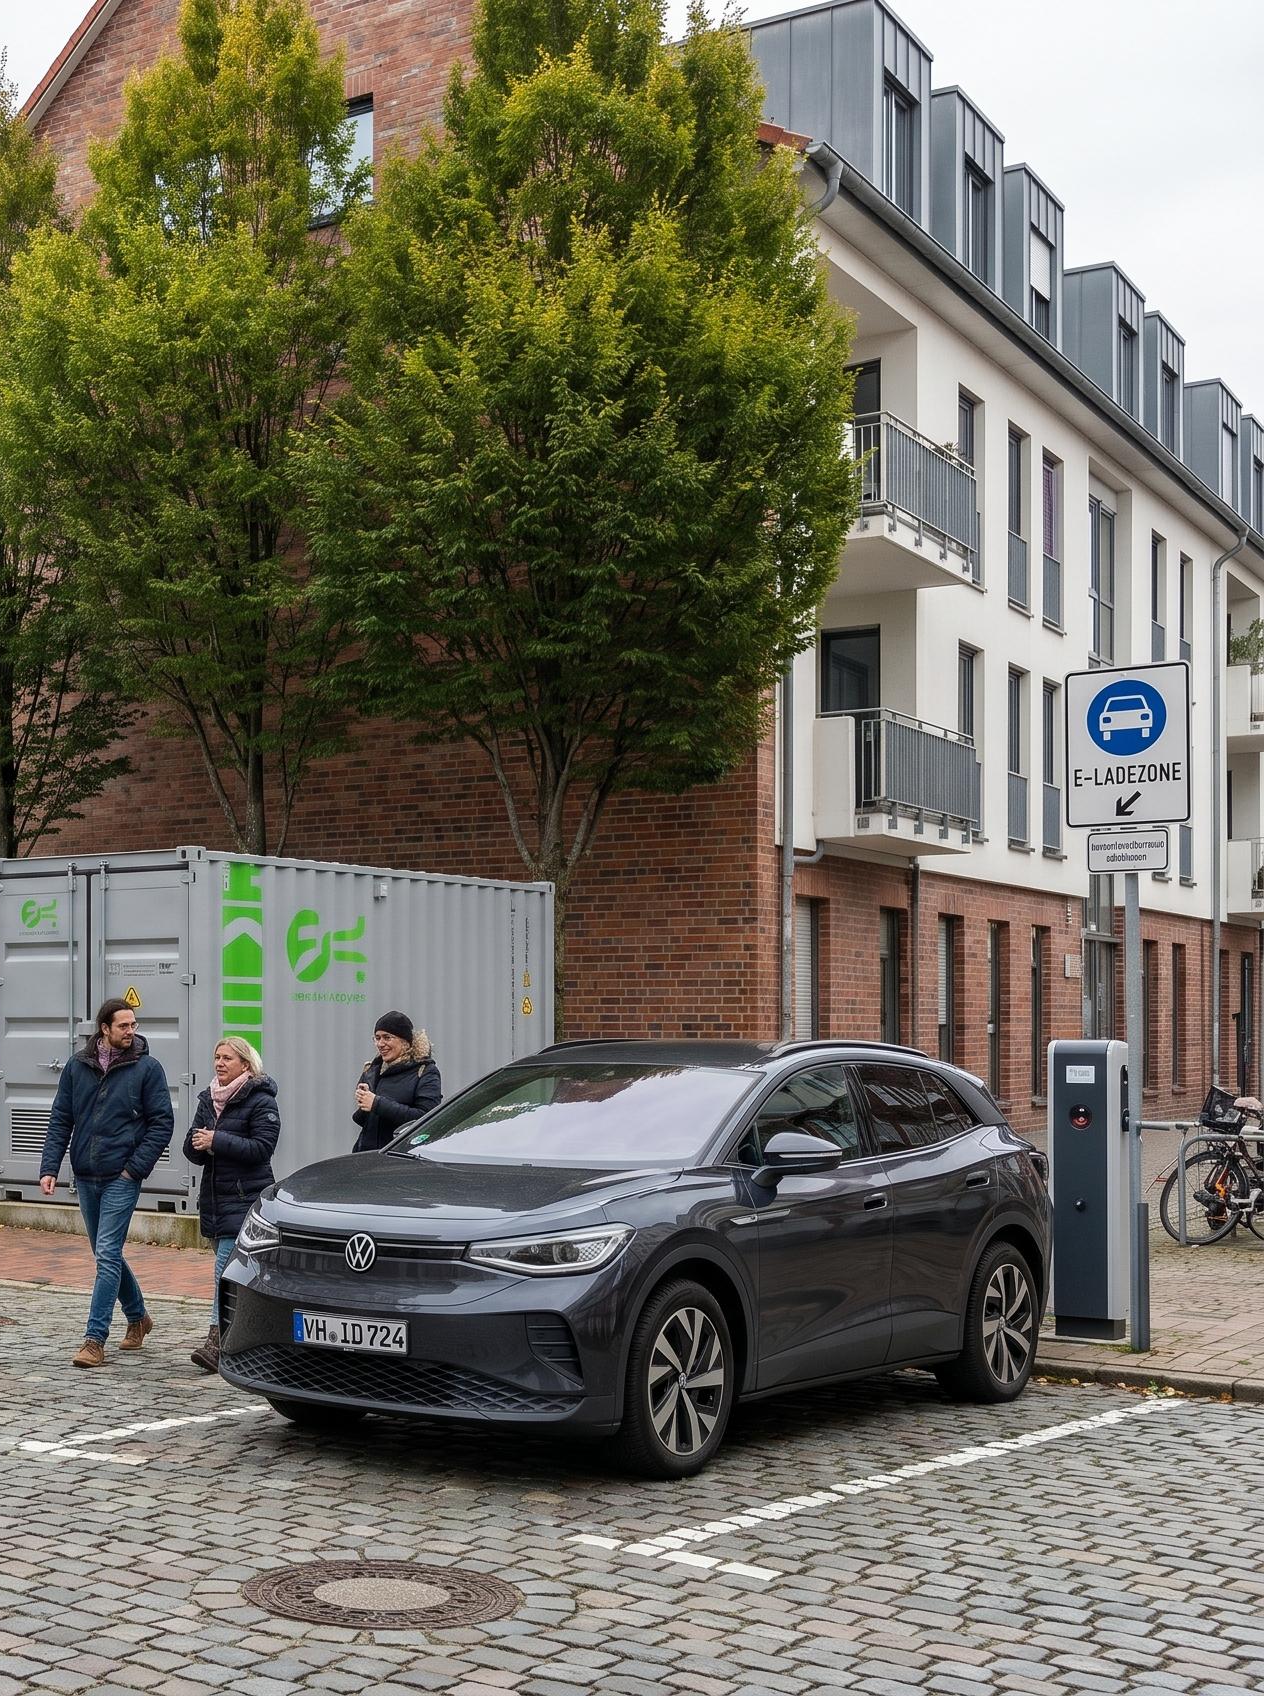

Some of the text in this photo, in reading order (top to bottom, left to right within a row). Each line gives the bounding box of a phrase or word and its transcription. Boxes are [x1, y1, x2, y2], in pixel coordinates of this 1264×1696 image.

[1074, 762, 1182, 787] E-LADEZONE
[303, 1317, 327, 1341] VH
[367, 1324, 404, 1348] 724
